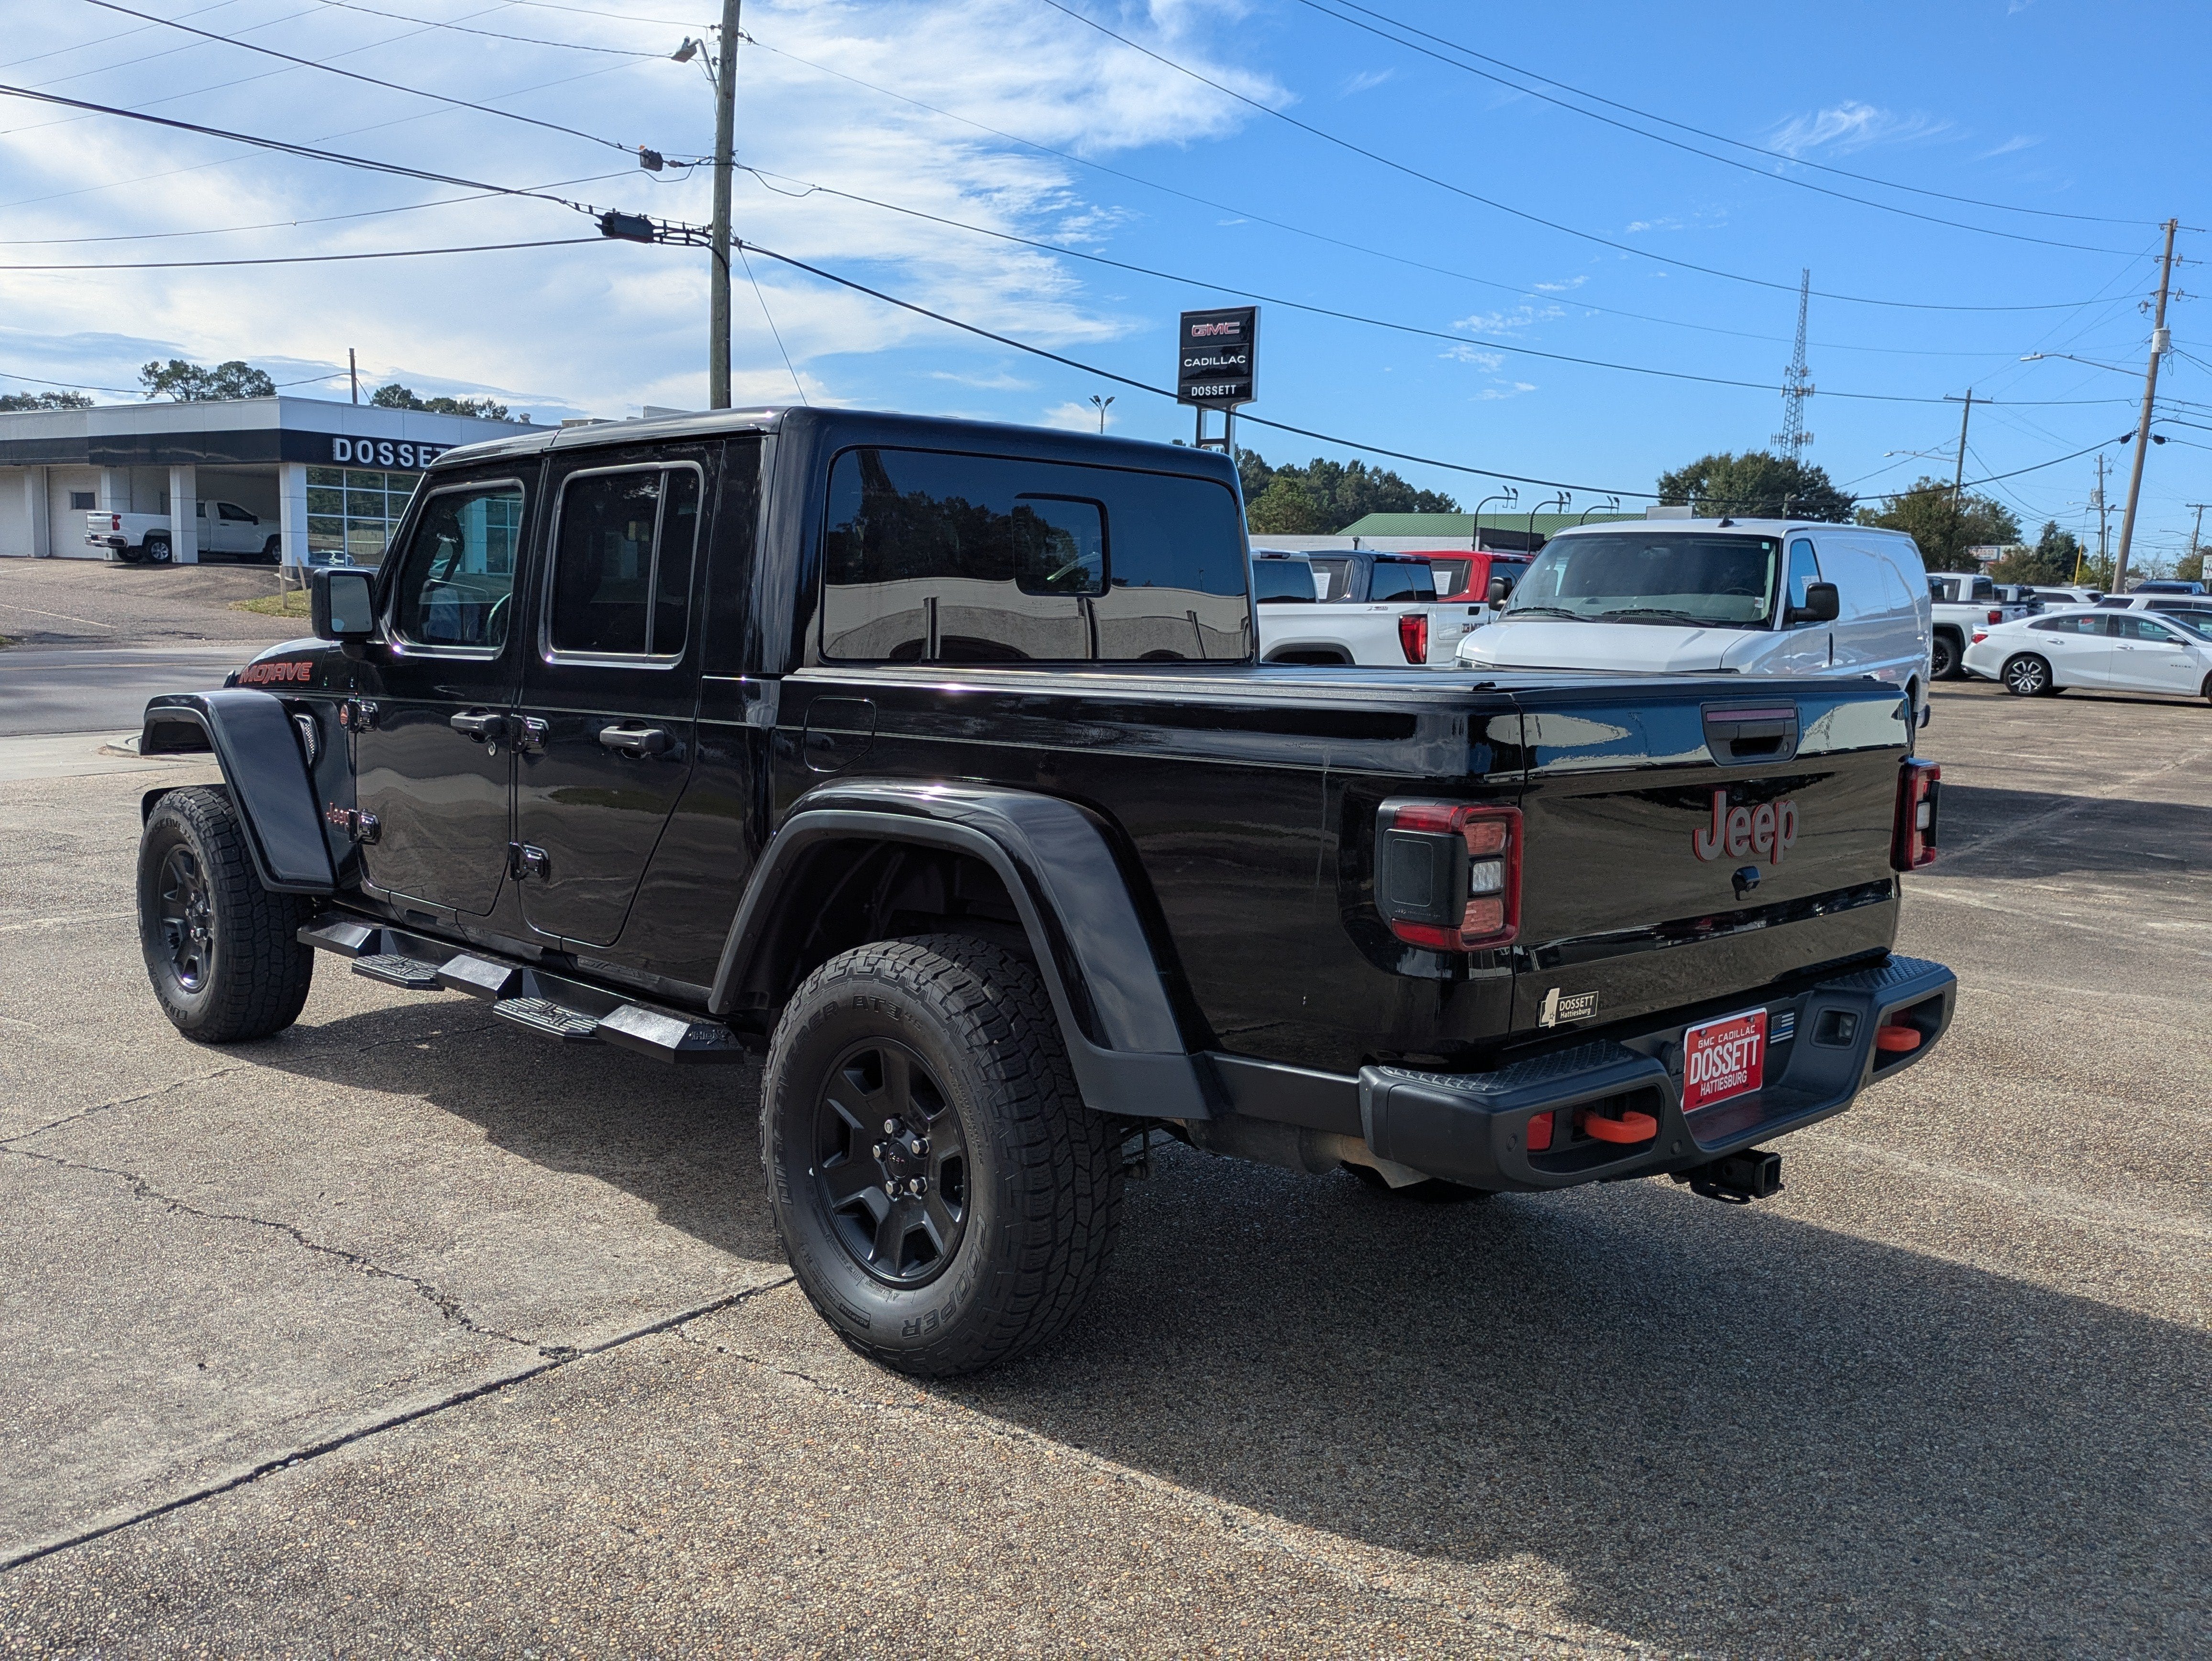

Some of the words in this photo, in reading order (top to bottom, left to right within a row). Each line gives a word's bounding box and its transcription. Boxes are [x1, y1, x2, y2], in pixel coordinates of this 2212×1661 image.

[1192, 322, 1240, 337] GMC
[1184, 355, 1246, 366] CADILLAC
[1192, 385, 1236, 396] DOSSETT
[238, 662, 313, 684] MOJAVE
[1692, 790, 1799, 865] Jeep
[1559, 996, 1594, 1011] DOSSETT
[1560, 1008, 1591, 1019] Hattiesburg
[1698, 1037, 1714, 1049] GMC
[1718, 1025, 1755, 1043] CADILLAC
[1690, 1034, 1760, 1085] DOSSETT
[1700, 1070, 1747, 1096] HATTIESBURG
[902, 1212, 987, 1339] COOPER
